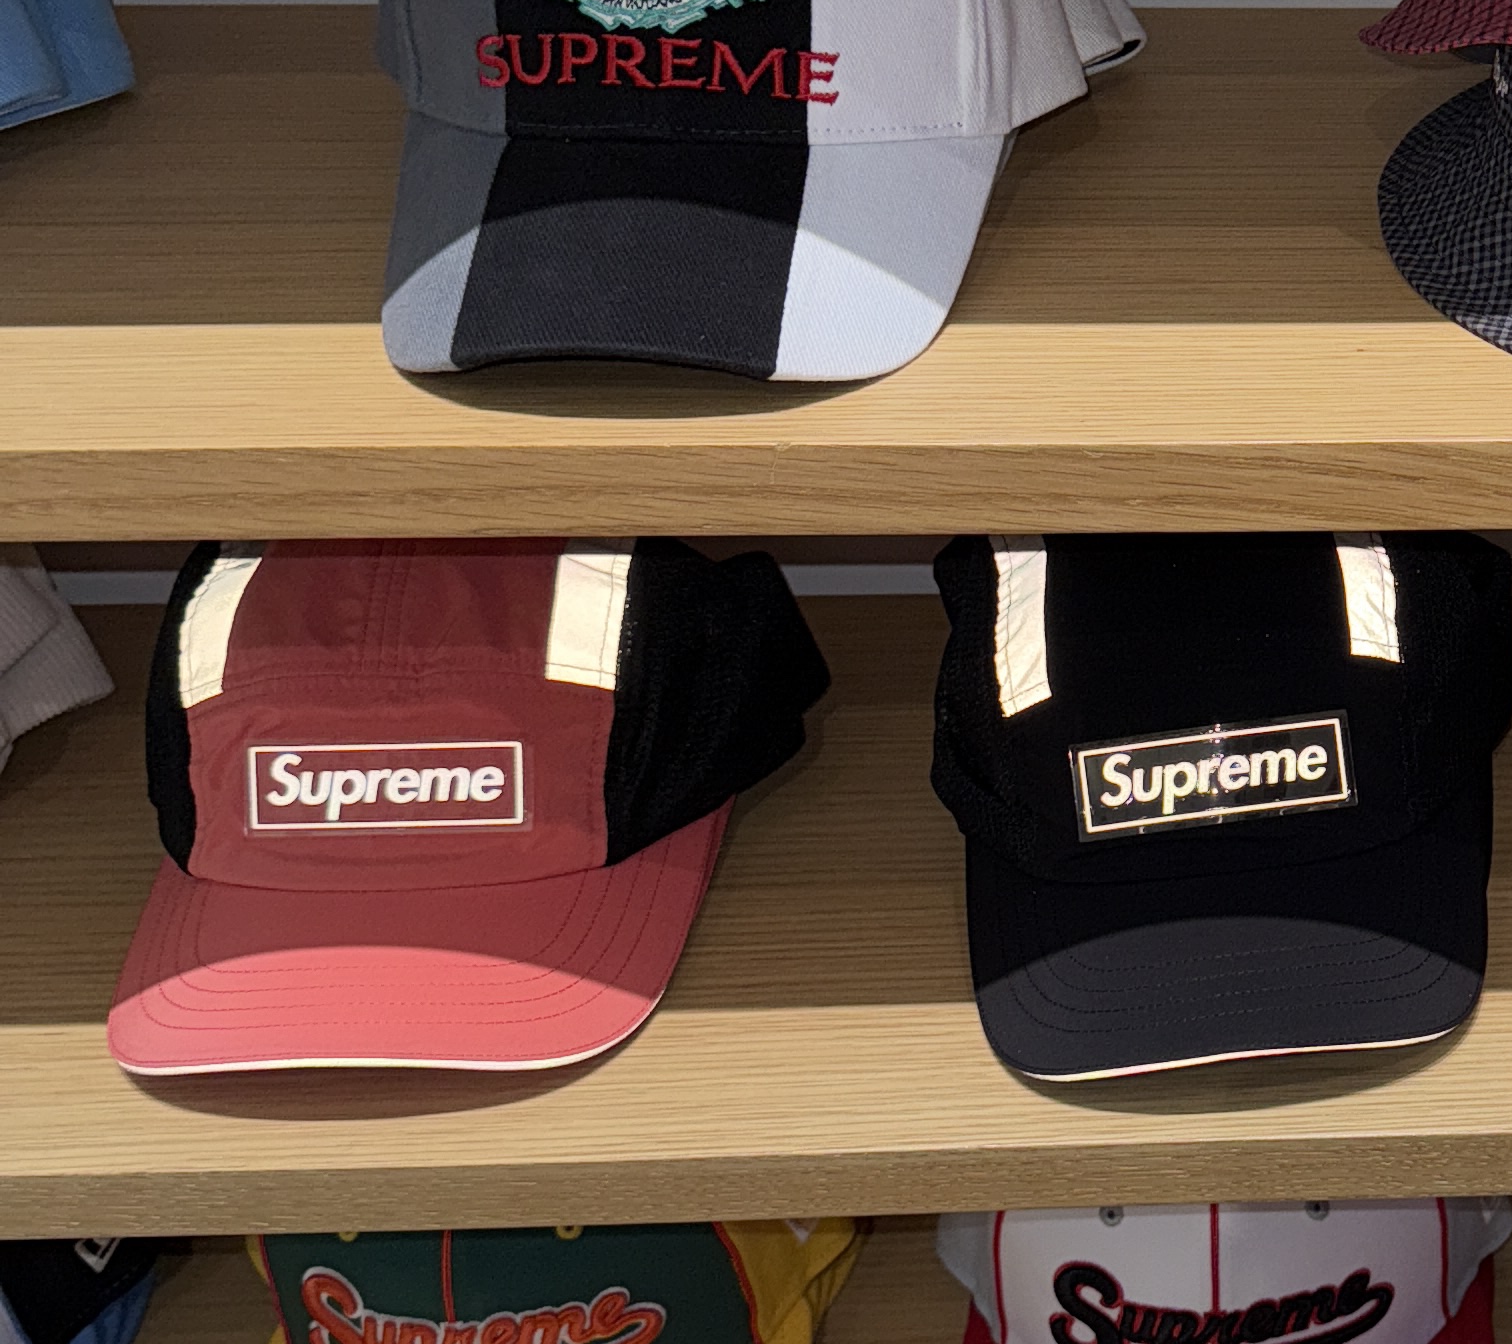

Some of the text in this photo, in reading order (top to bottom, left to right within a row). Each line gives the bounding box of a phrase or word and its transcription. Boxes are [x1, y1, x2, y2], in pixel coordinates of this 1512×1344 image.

[476, 32, 840, 107] SUPREME
[266, 753, 505, 821] Supreme
[1100, 744, 1328, 816] Supreme
